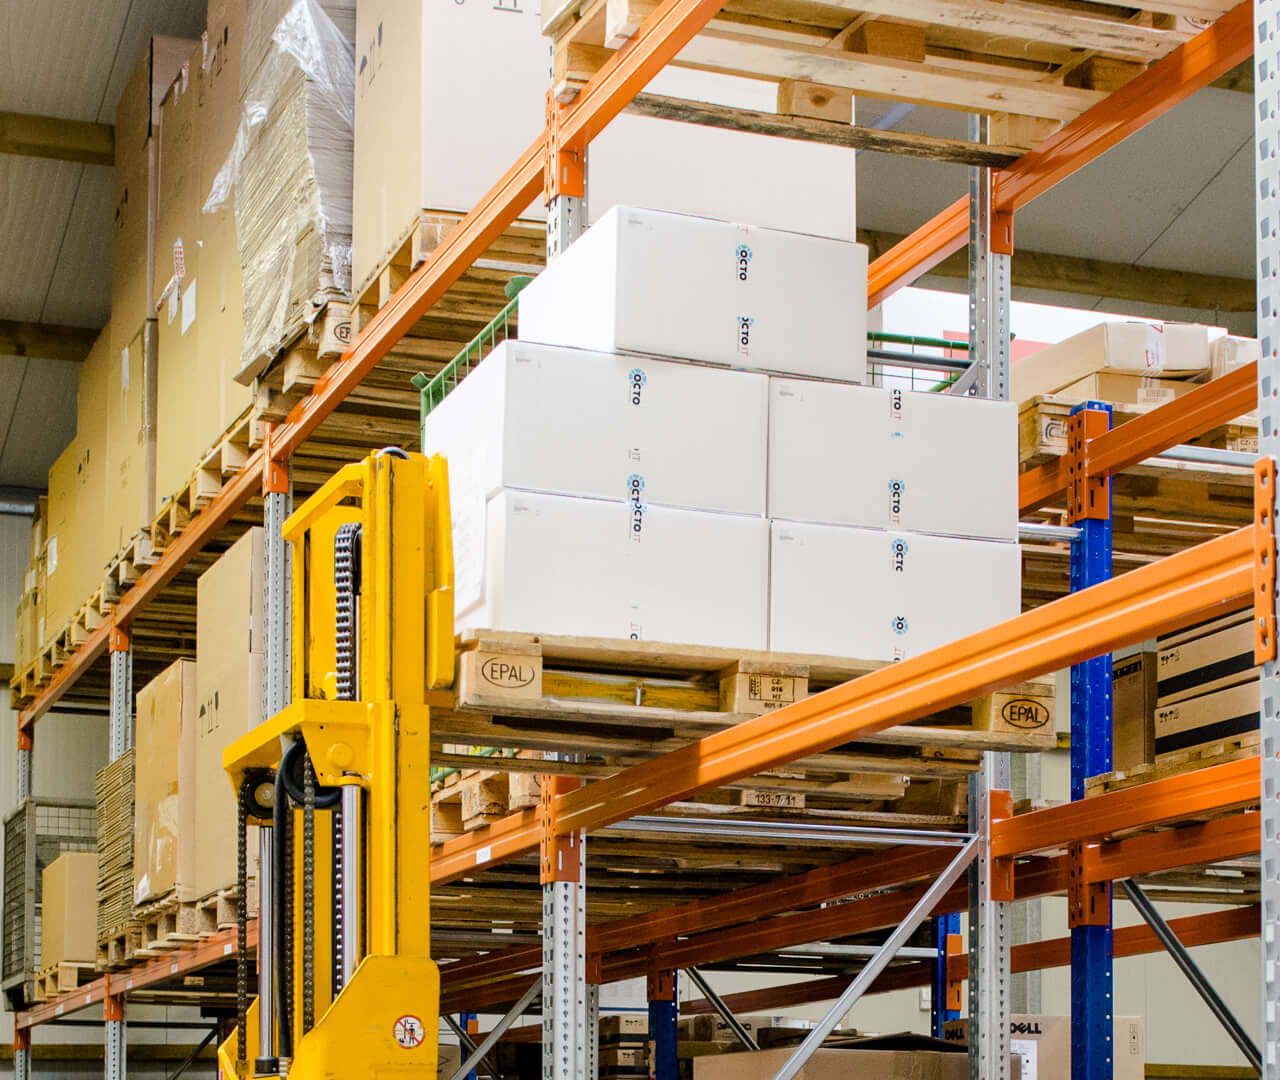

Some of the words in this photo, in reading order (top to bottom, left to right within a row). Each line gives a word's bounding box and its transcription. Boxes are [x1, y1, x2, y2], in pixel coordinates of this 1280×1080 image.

[489, 662, 529, 683] EPAL
[1009, 704, 1042, 724] EPAL
[1009, 1022, 1042, 1034] DELL
